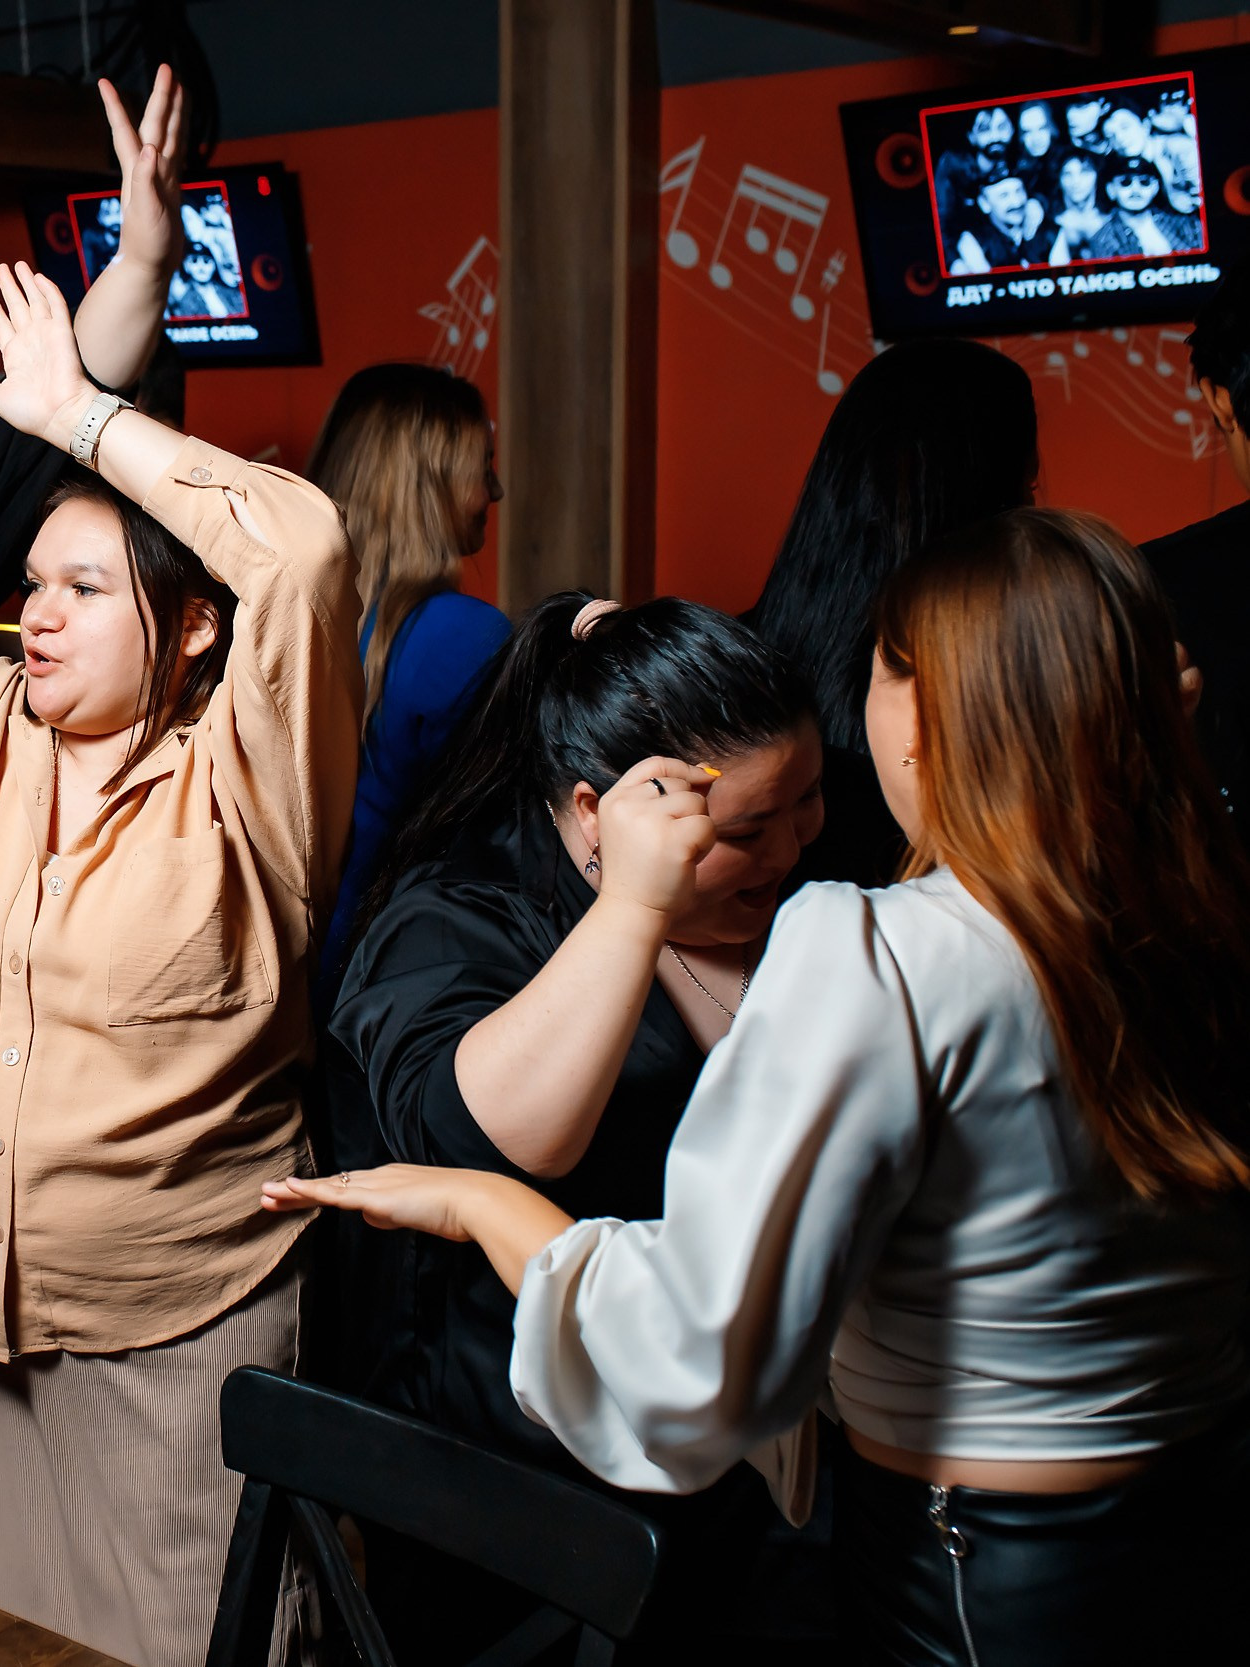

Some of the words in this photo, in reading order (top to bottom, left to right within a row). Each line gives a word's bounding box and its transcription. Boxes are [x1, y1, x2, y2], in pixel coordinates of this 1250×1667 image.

[946, 283, 993, 307] ДДТ
[1007, 278, 1056, 299] ЧТО
[1056, 269, 1137, 296] ТАКОЕ
[1138, 262, 1221, 288] ОСЕНЬ
